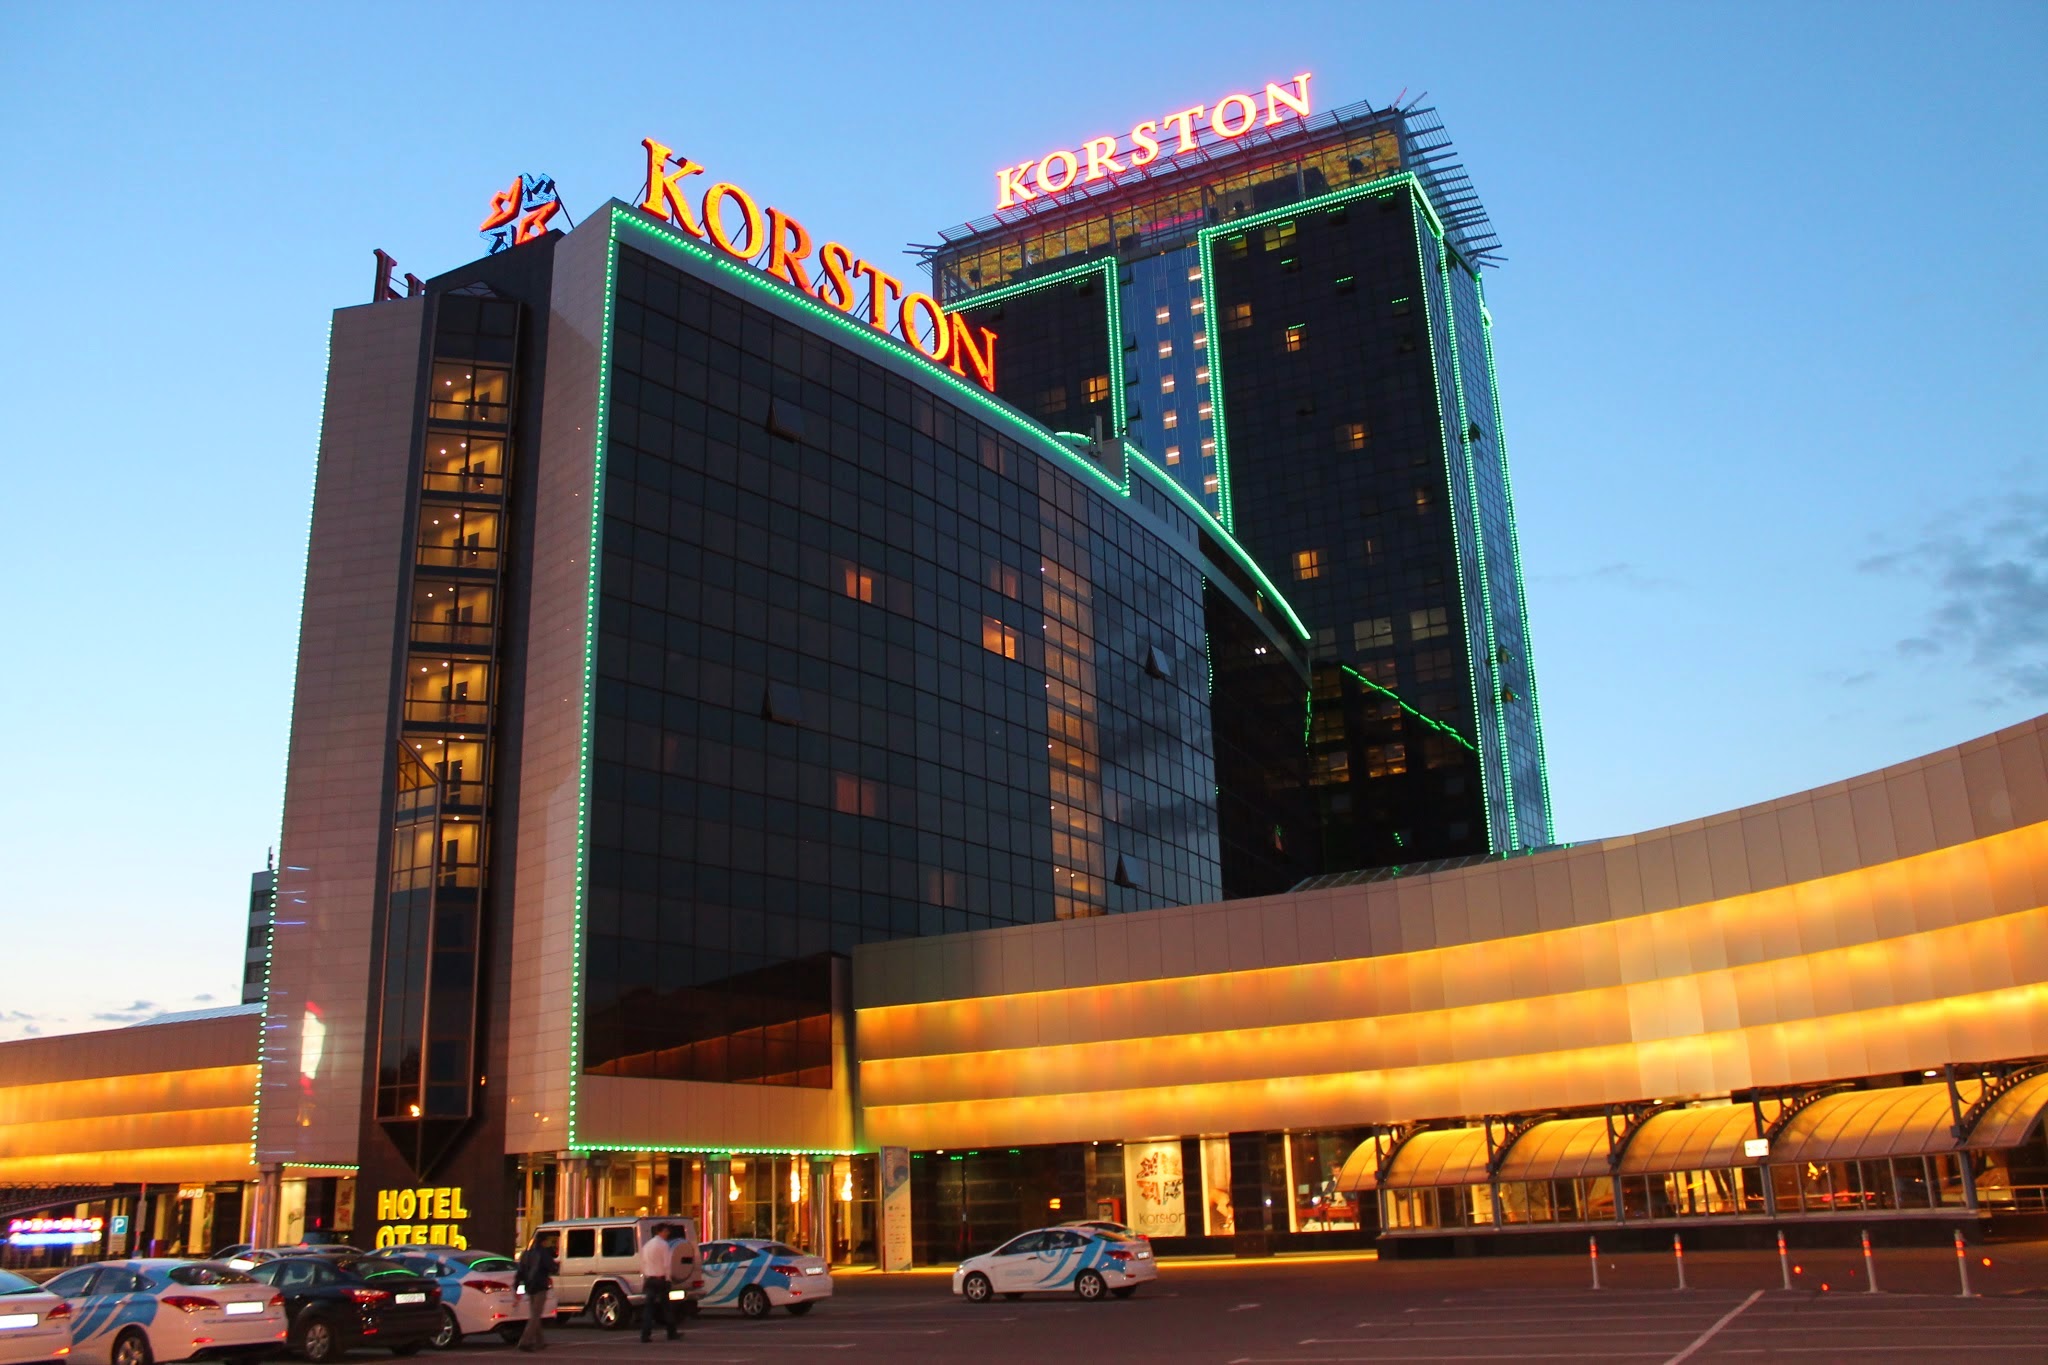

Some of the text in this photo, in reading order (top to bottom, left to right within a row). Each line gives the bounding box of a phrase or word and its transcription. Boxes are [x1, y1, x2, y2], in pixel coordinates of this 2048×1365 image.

[995, 72, 1312, 210] KORSTON
[638, 137, 998, 392] KORSTON
[375, 1224, 467, 1251] ОТЕЛЬ
[377, 1187, 468, 1220] HOTEL
